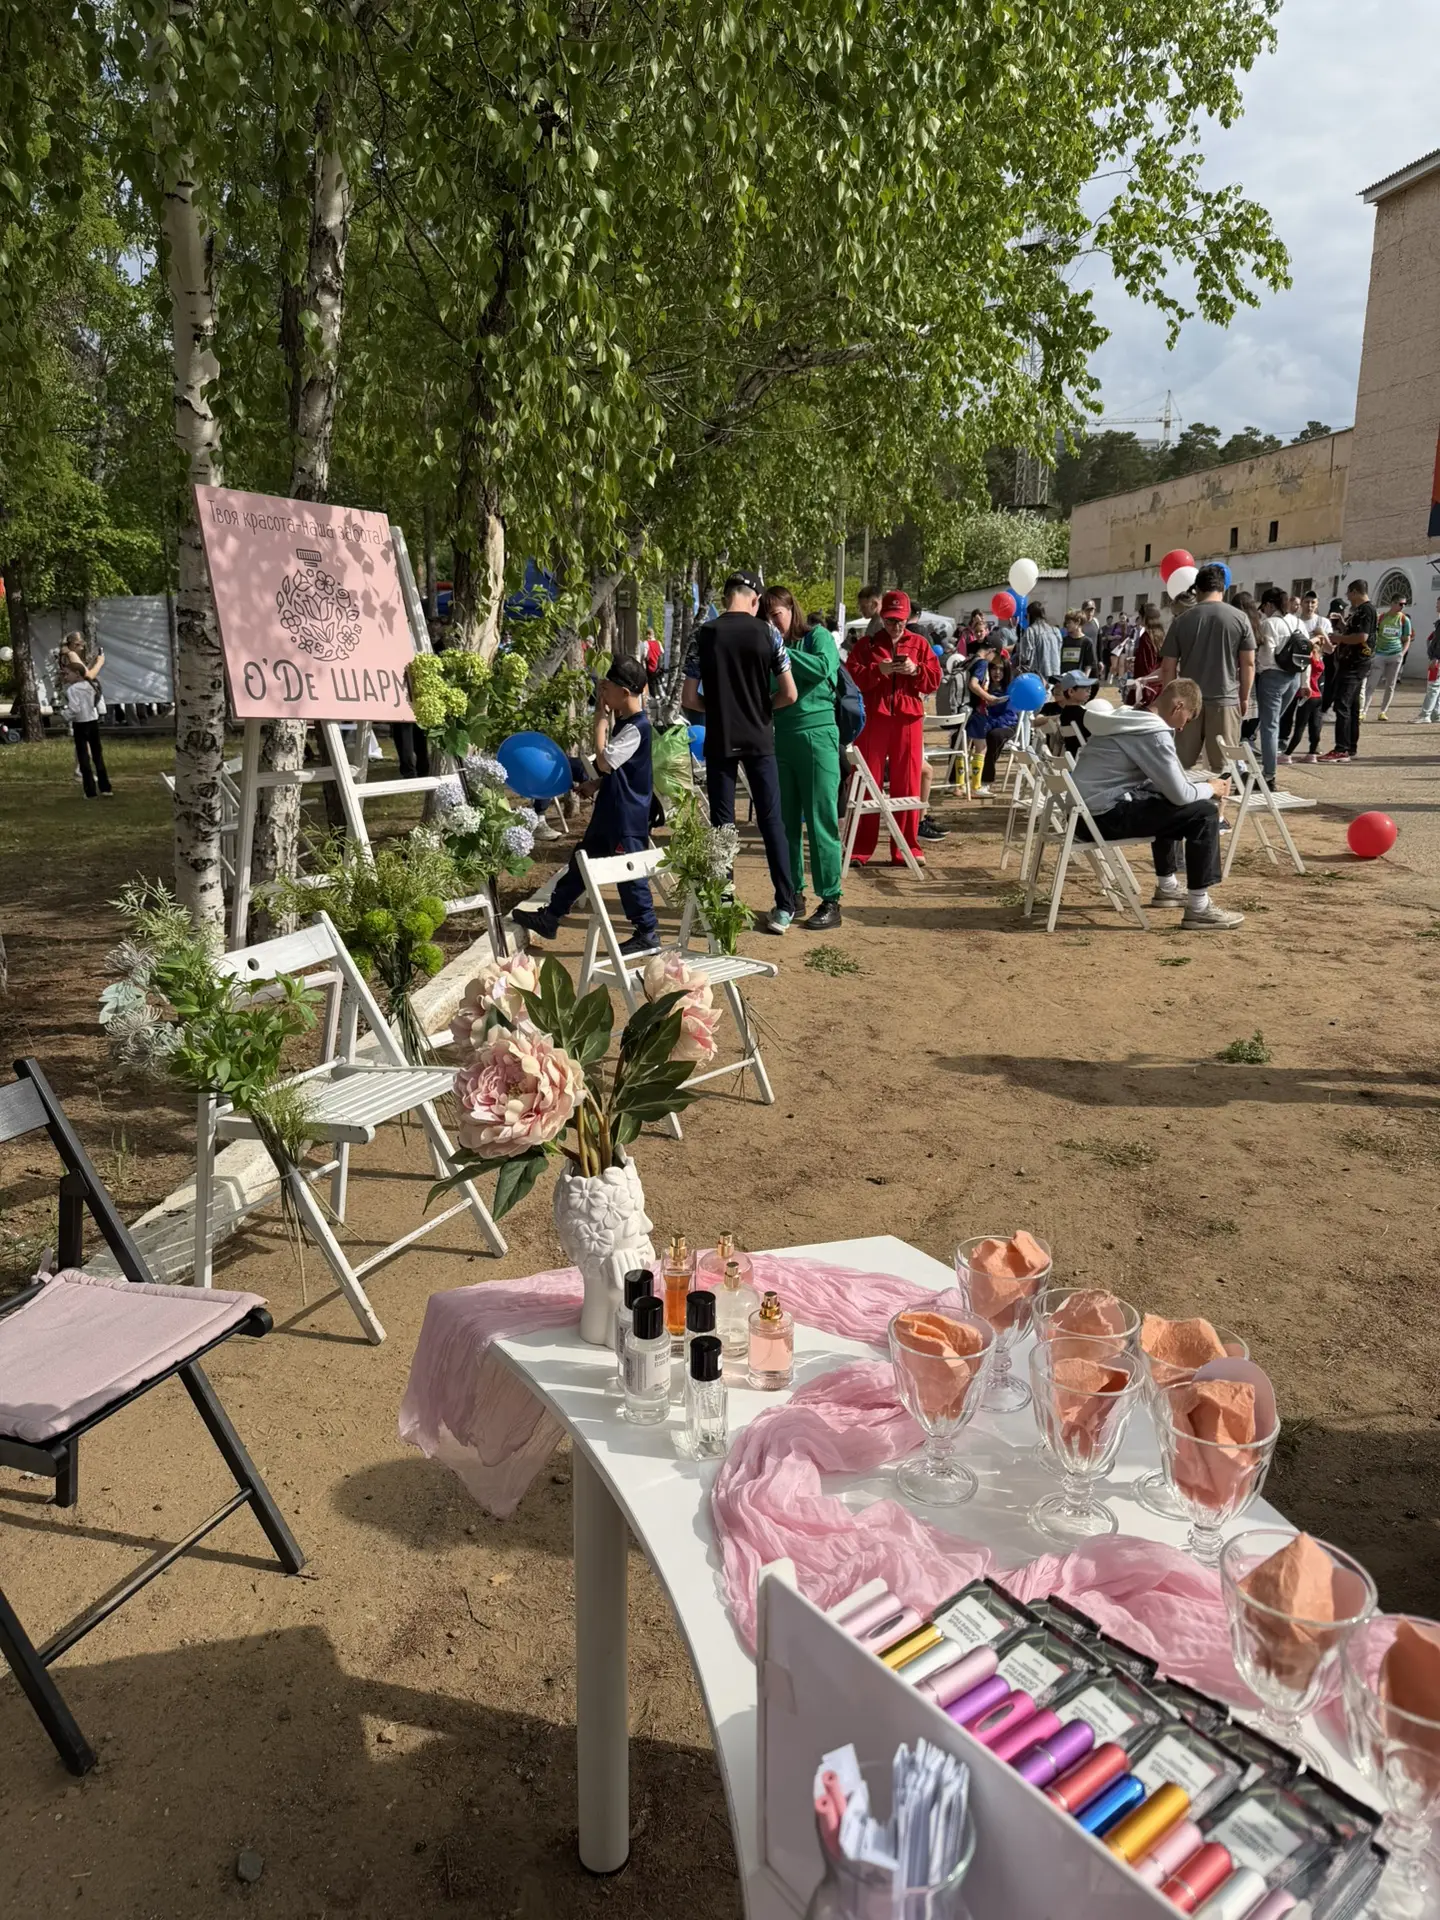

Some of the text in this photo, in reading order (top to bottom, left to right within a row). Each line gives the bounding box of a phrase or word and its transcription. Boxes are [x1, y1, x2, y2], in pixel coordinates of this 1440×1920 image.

[208, 500, 383, 544] Твоя красота-наша забота!
[331, 668, 412, 707] ШАРМ
